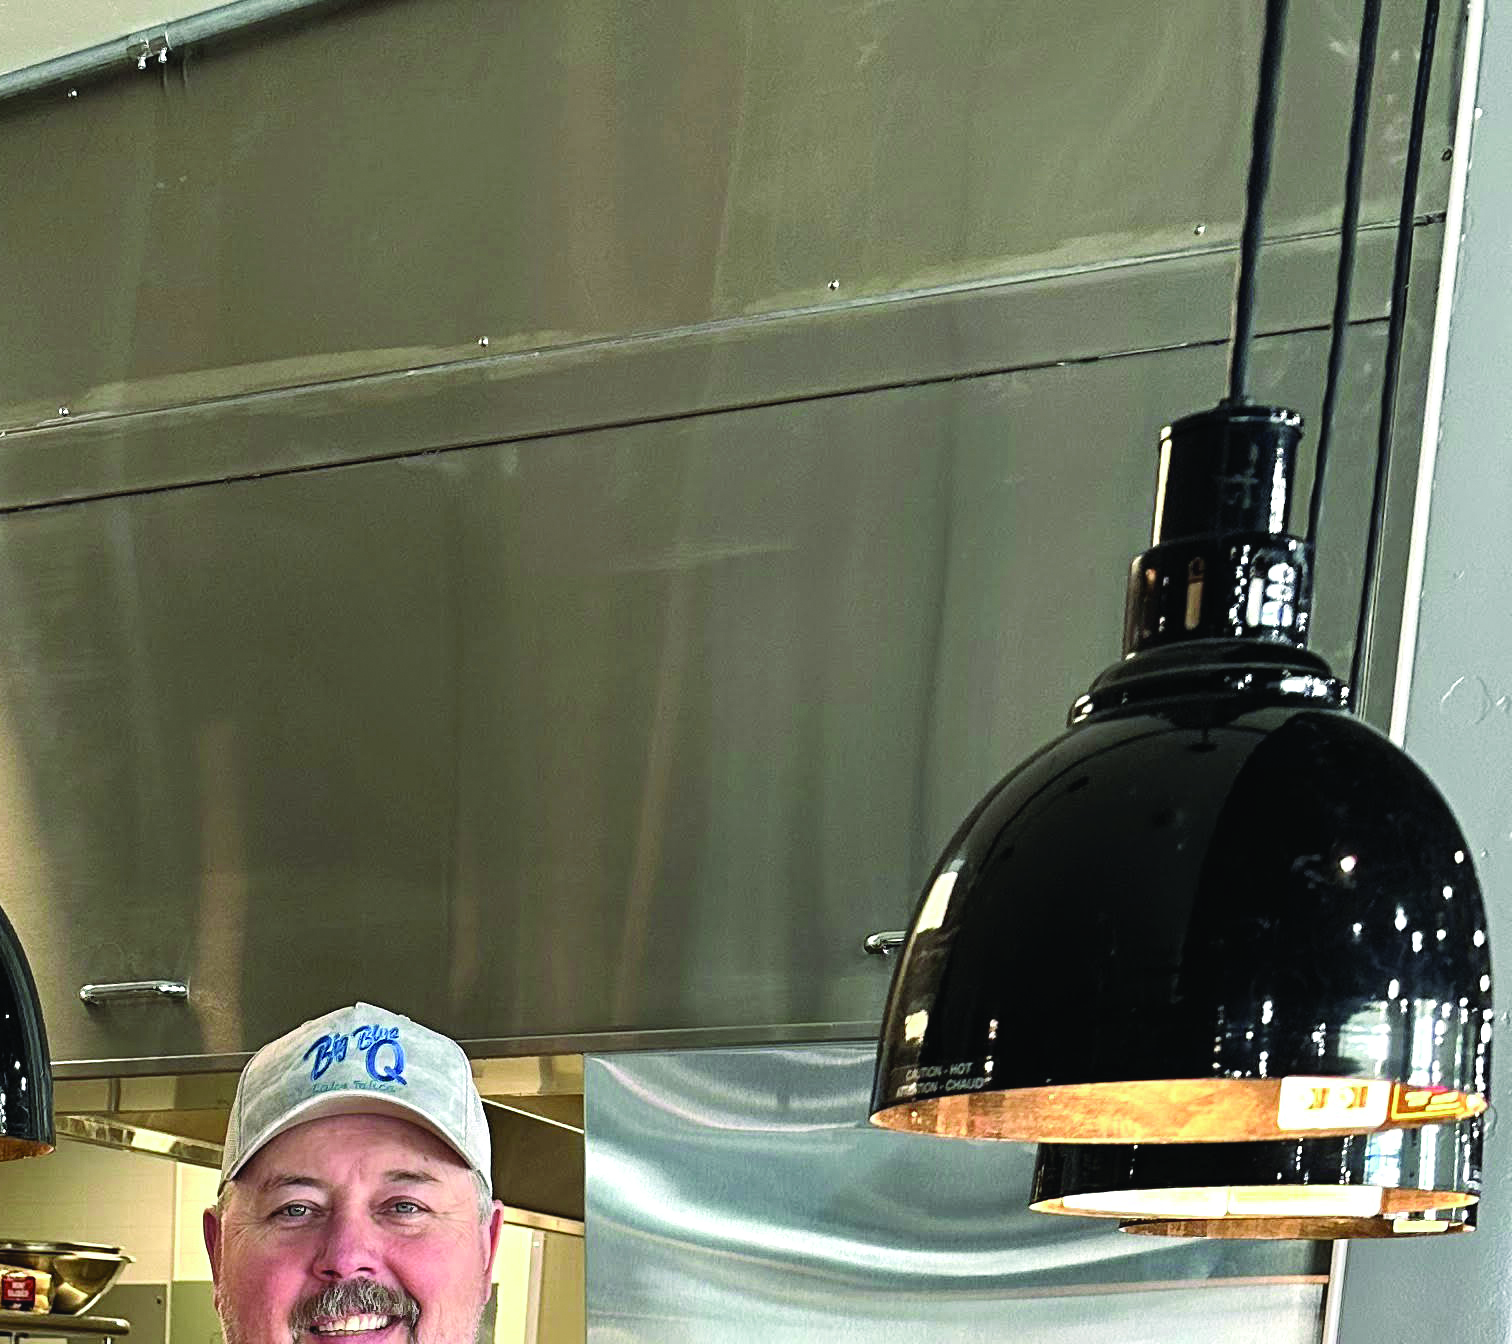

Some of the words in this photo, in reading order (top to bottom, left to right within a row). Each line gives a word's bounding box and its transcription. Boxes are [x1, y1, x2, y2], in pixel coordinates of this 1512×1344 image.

[303, 1032, 349, 1081] Big
[352, 1024, 400, 1051] Blue
[365, 1038, 408, 1086] Q
[949, 1062, 974, 1075] HOT
[945, 1076, 985, 1092] CHAUD
